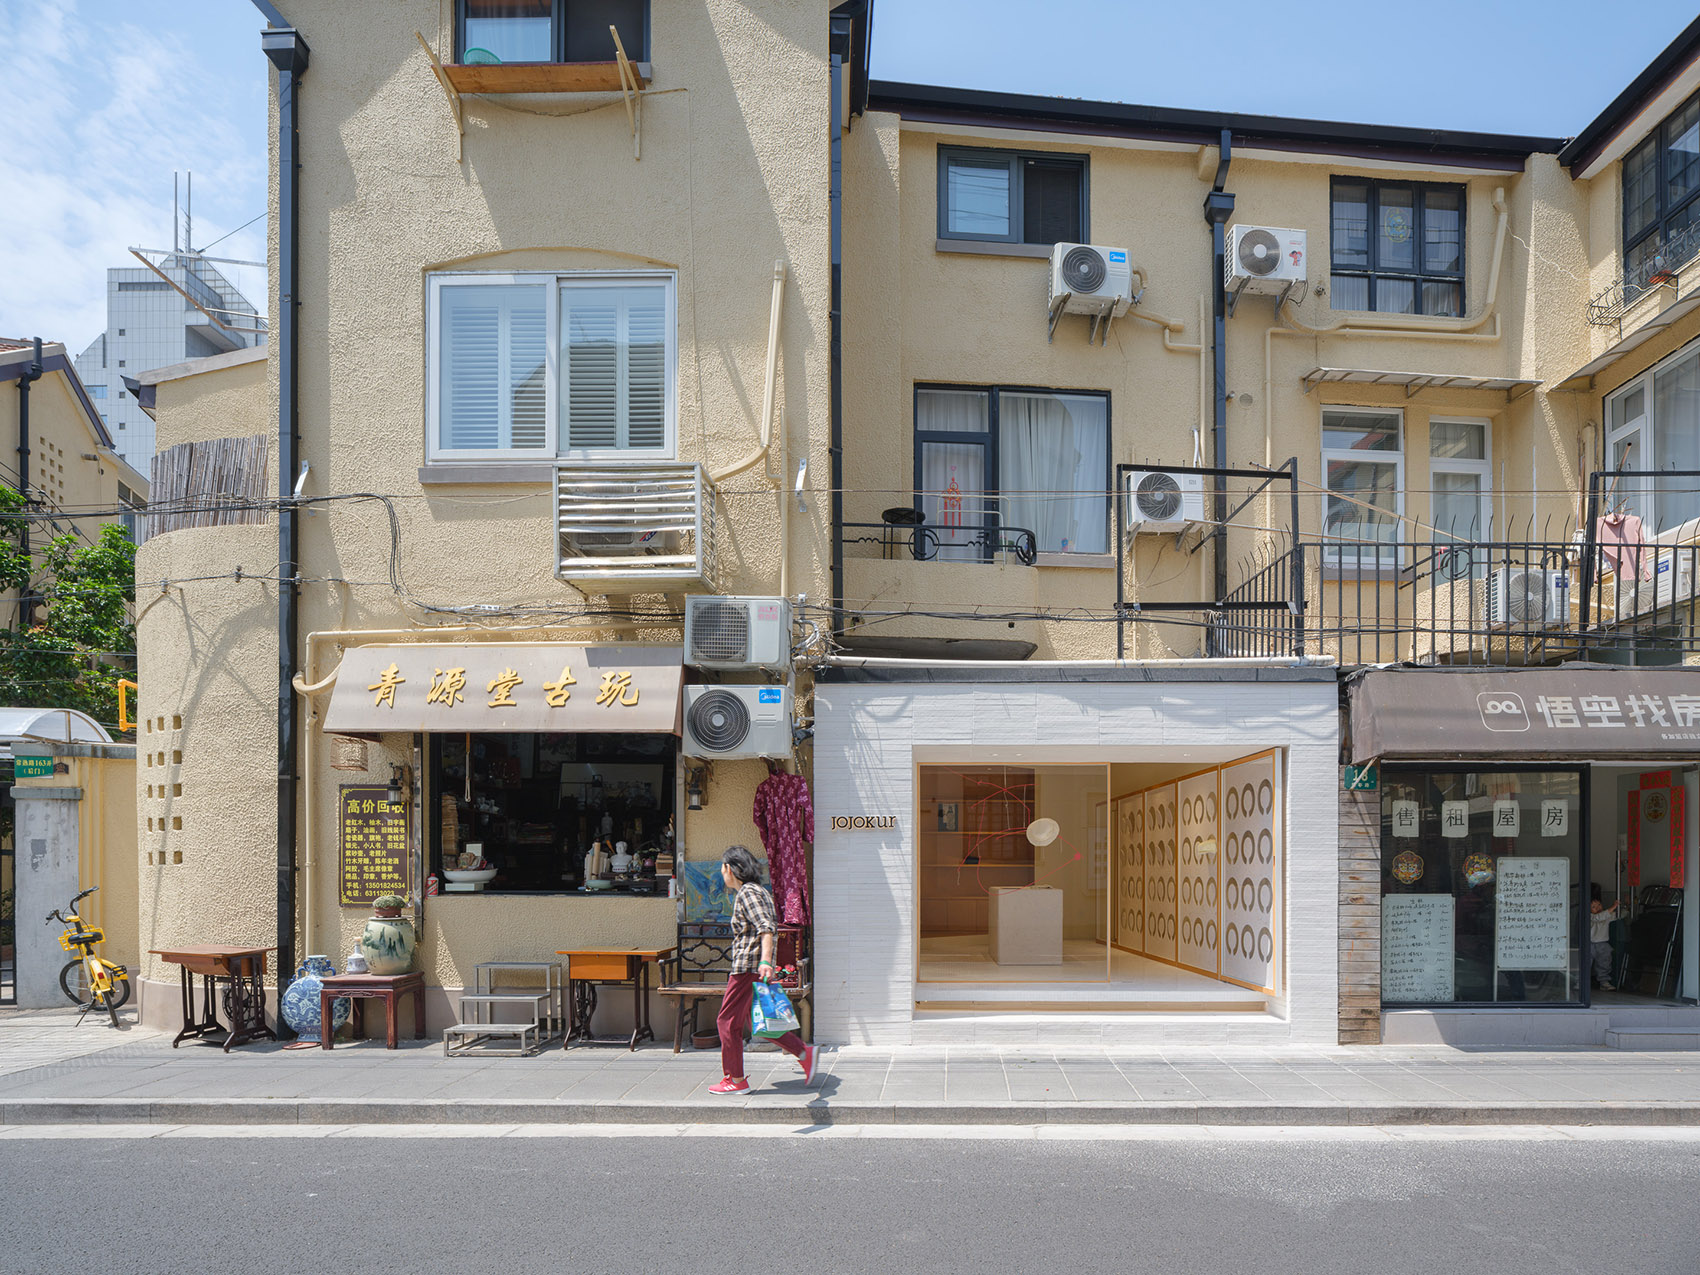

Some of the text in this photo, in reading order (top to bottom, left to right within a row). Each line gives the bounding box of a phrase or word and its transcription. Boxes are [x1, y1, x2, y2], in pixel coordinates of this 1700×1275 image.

[367, 662, 639, 708] 青源堂古玩
[1536, 694, 1700, 728] 悟空找房
[347, 799, 405, 814] 高价回收
